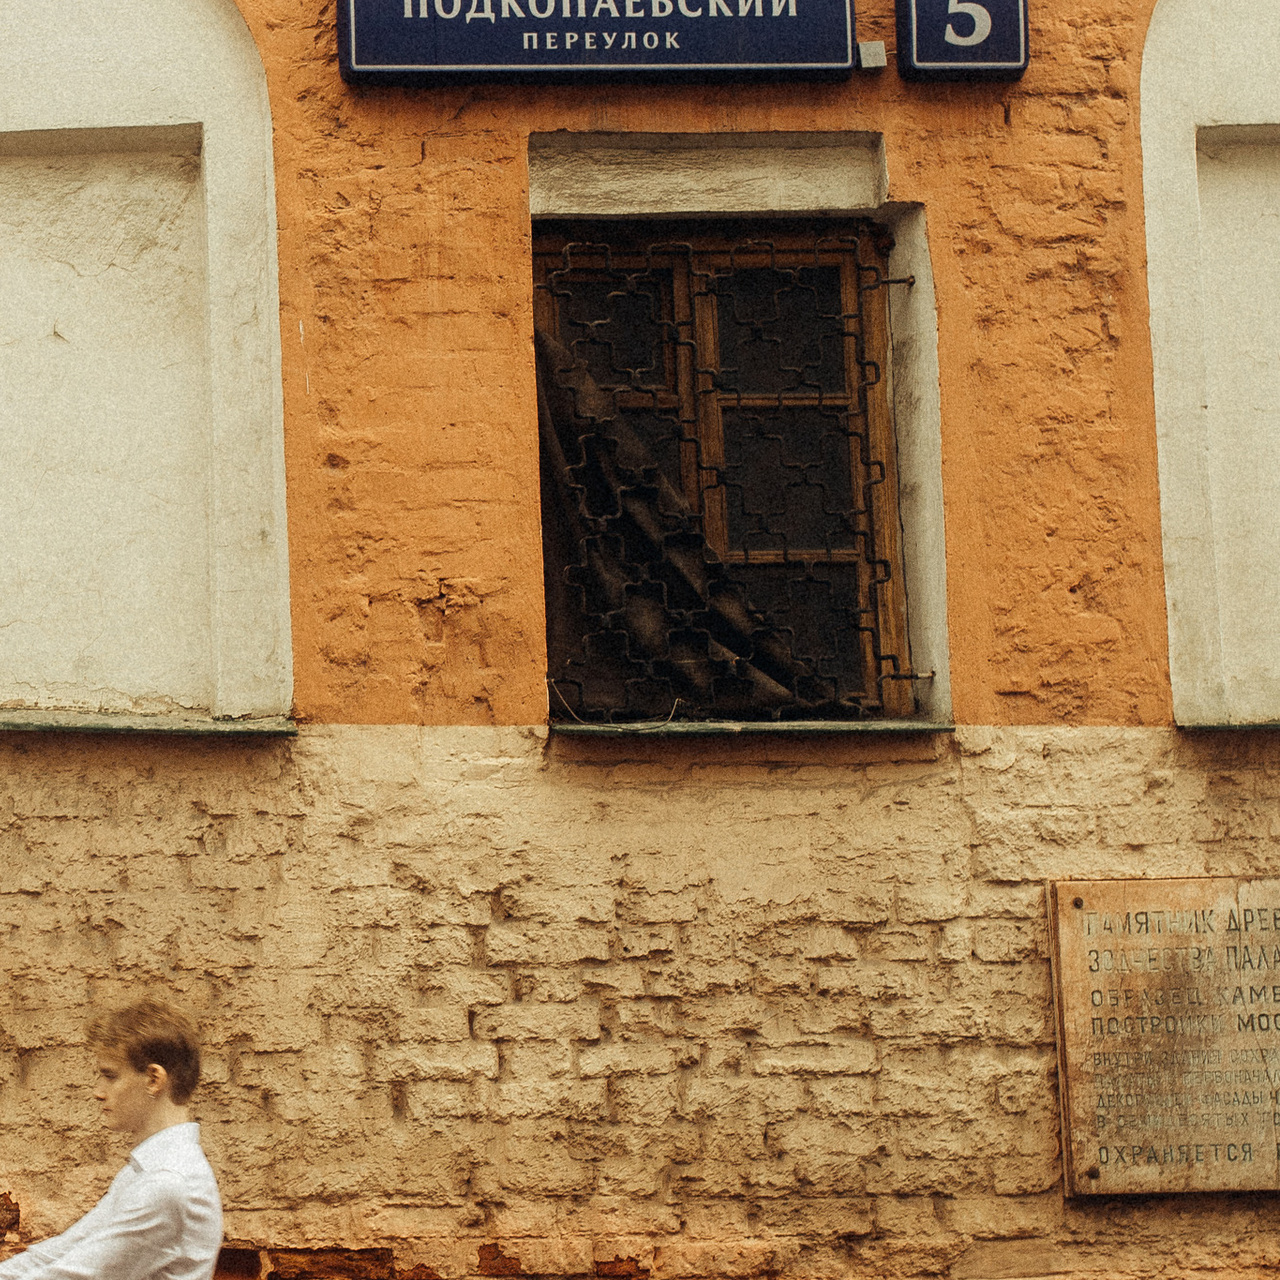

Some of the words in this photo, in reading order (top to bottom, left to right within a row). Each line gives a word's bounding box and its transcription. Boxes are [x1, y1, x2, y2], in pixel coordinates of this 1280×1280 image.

[523, 32, 679, 49] ПЕРЕУЛОК
[1084, 909, 1215, 936] ПАМЯТНИК
[1087, 946, 1217, 973] ЗОДЧЕСТВА
[1098, 1142, 1253, 1165] ОХРАНЯЕТСЯ
